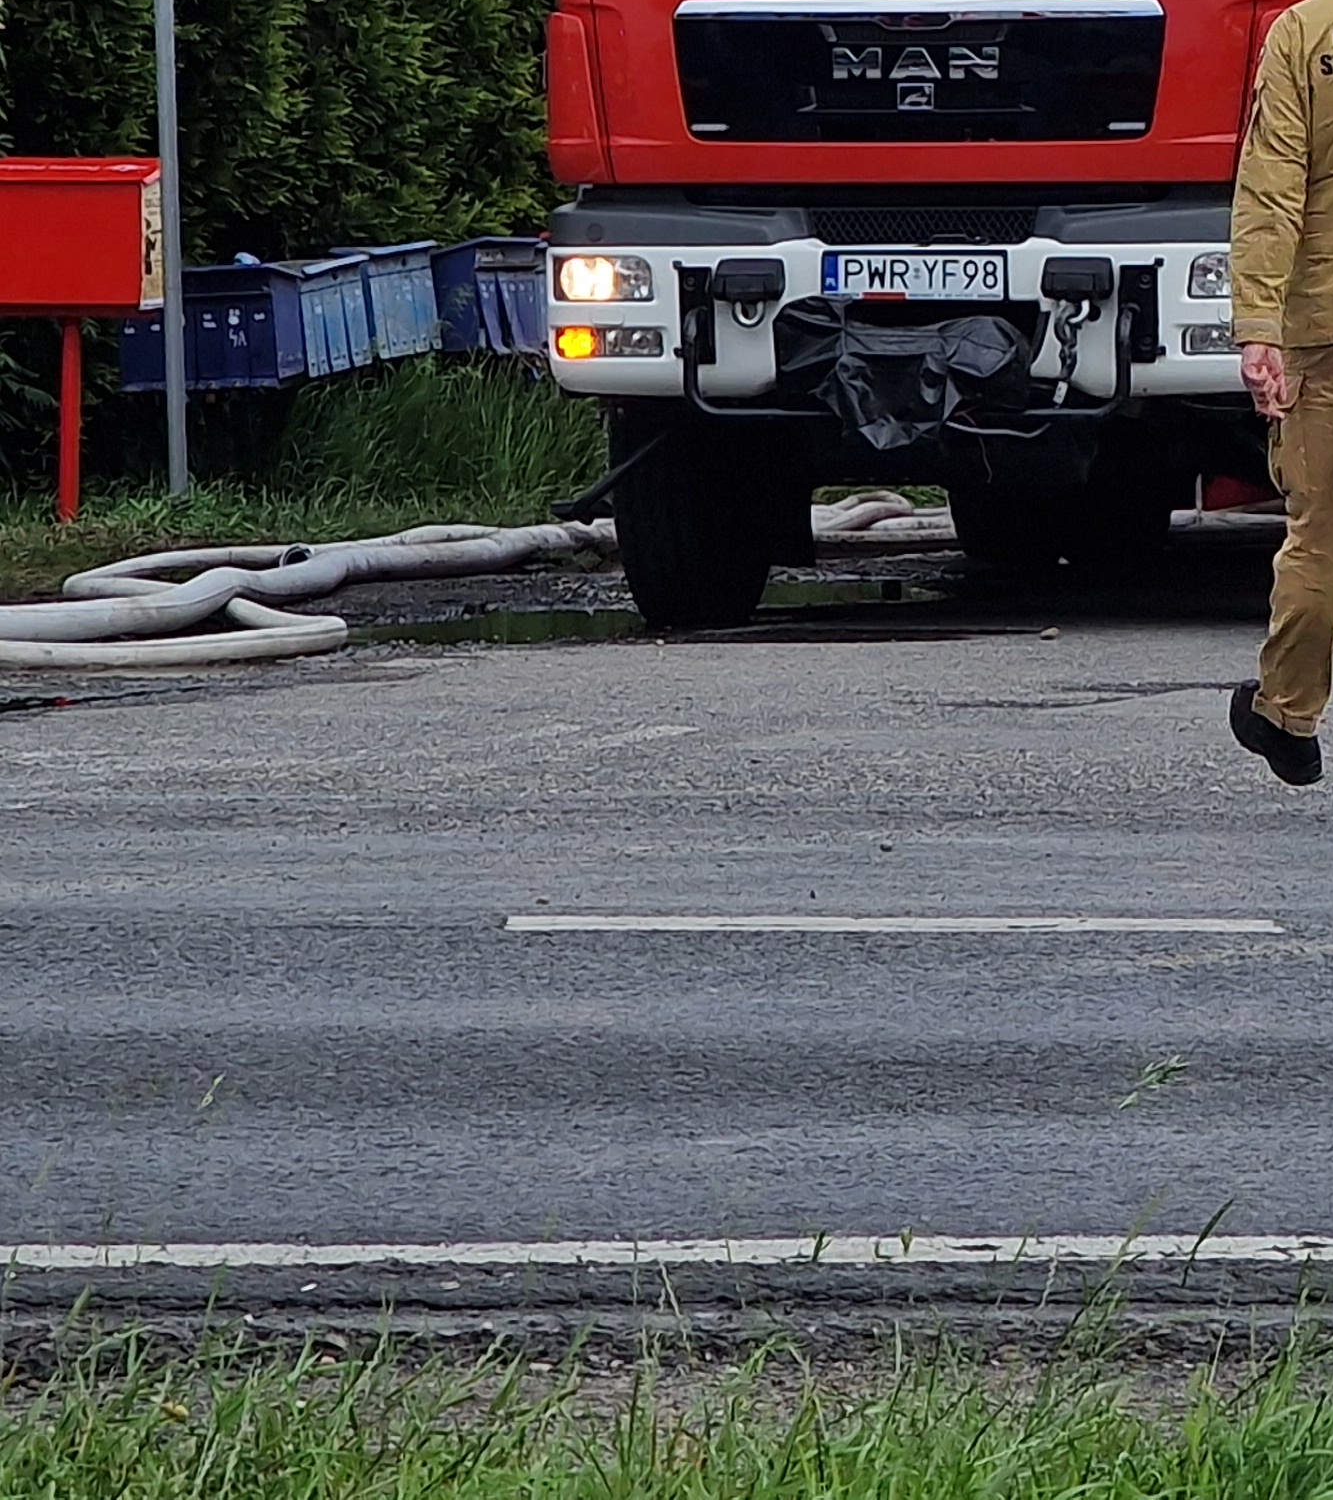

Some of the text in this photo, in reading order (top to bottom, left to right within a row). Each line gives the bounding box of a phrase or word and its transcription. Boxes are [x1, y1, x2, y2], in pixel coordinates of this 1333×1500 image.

[832, 47, 1000, 79] MAN
[844, 259, 998, 290] PWR YF98
